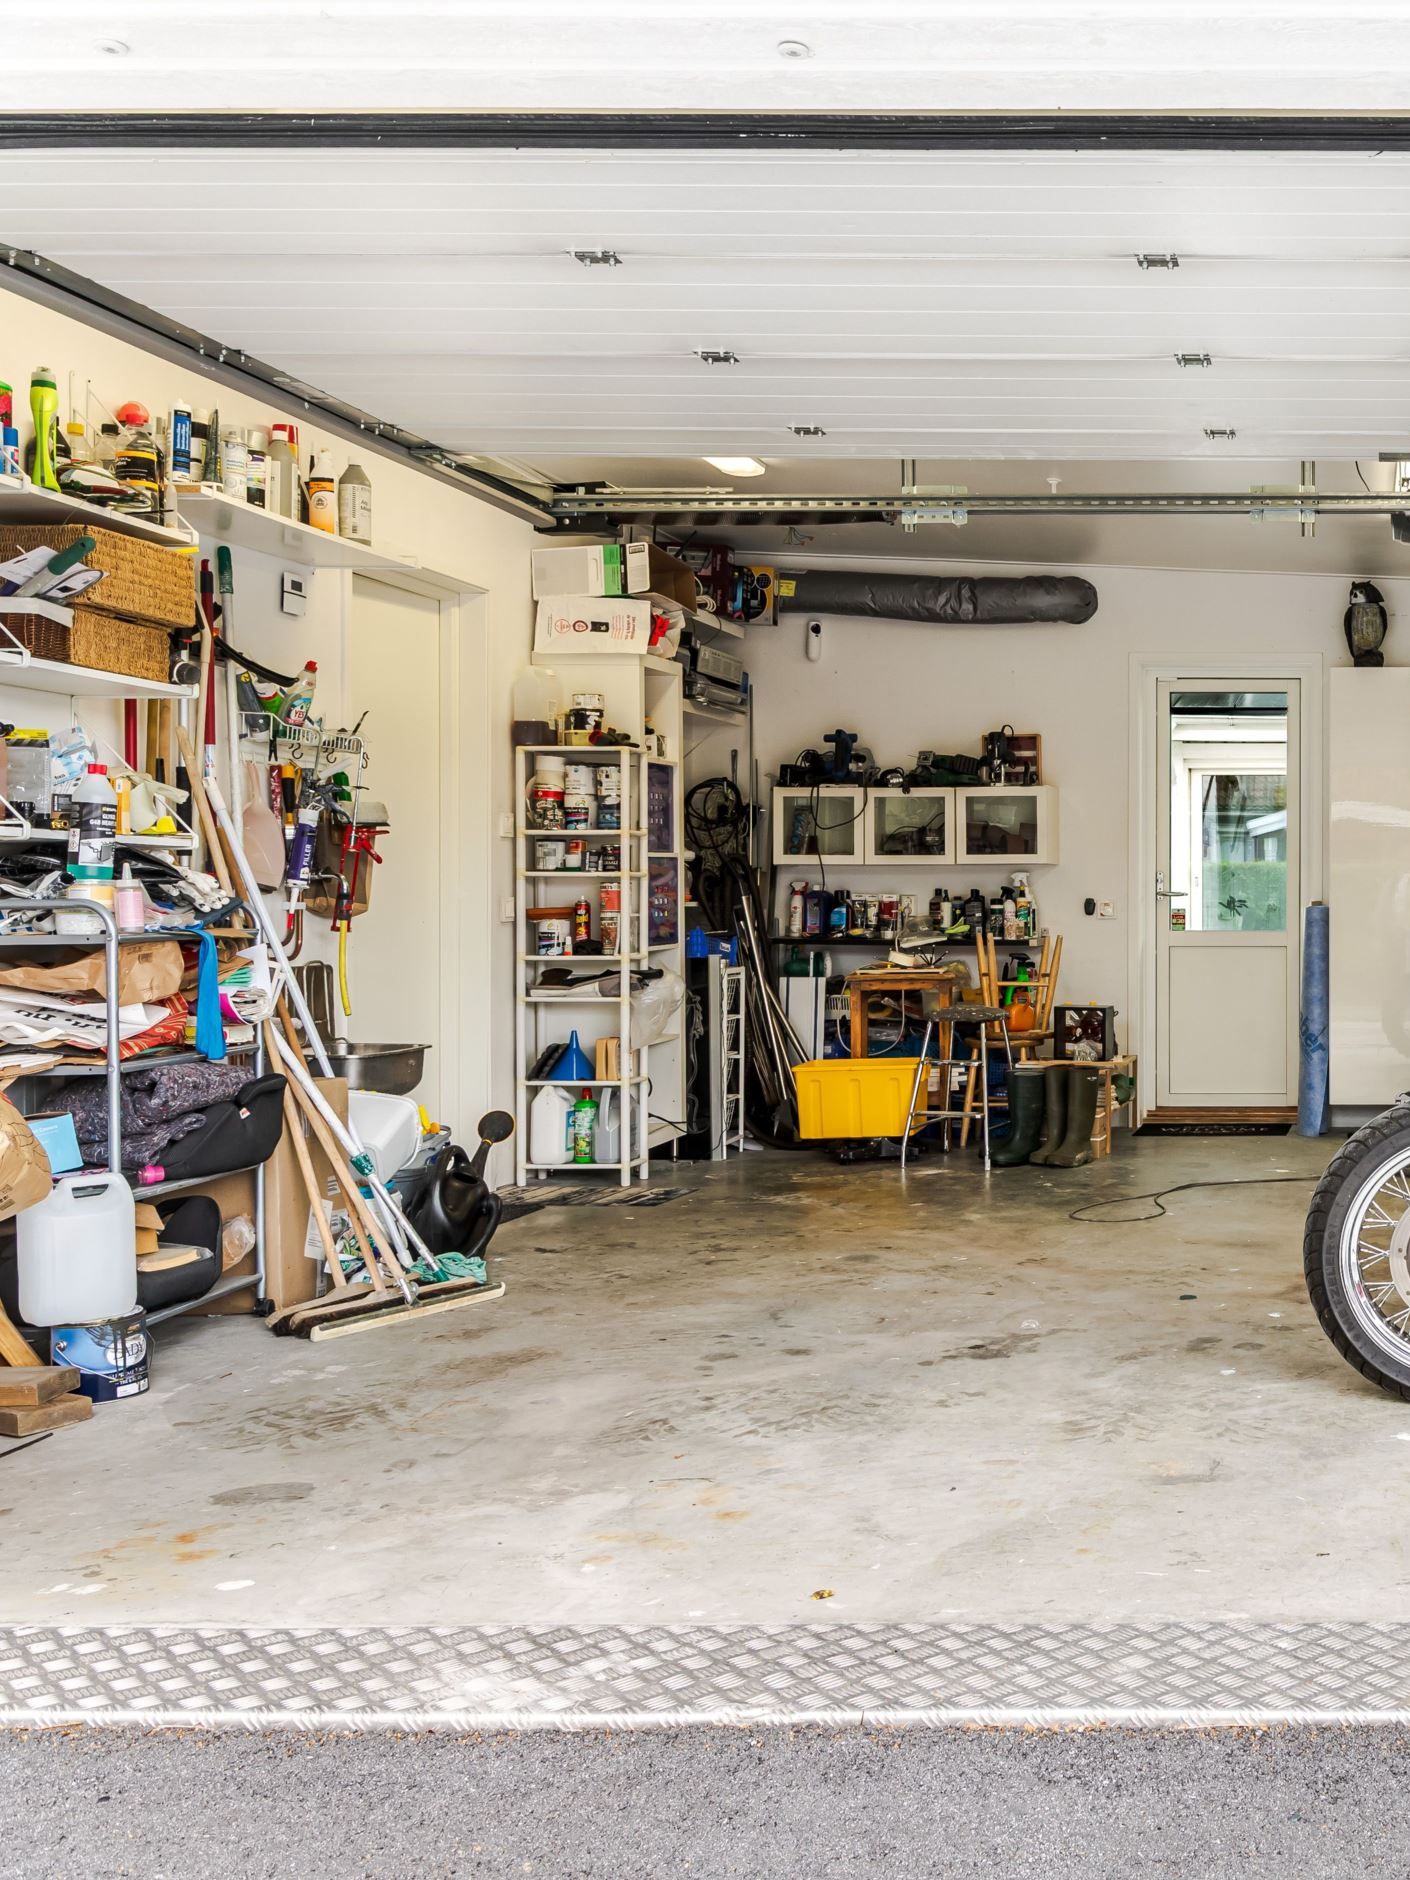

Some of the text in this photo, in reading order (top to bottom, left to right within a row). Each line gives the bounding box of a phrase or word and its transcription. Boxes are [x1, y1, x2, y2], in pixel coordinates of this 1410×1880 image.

[294, 709, 305, 719] YES
[302, 844, 313, 866] FILLER
[1324, 1243, 1356, 1333] METZELER
